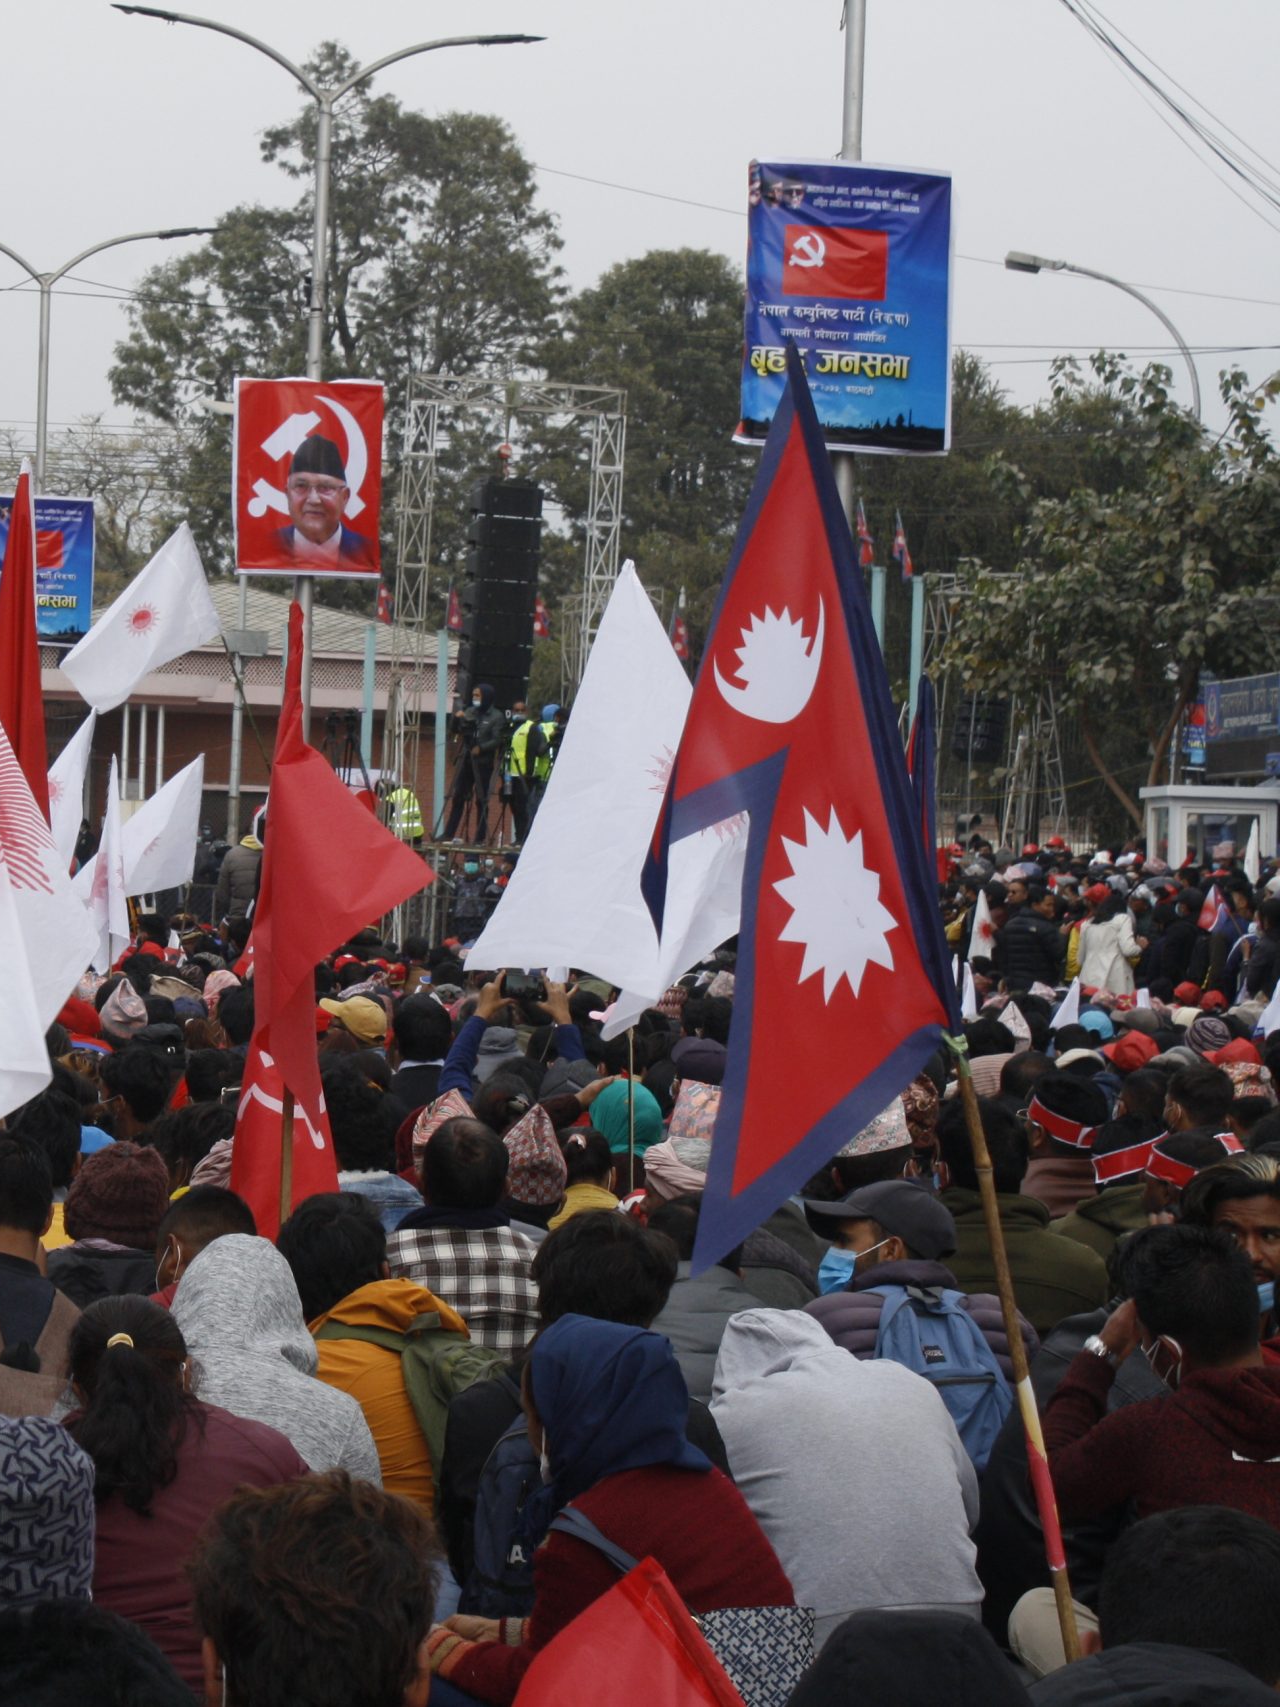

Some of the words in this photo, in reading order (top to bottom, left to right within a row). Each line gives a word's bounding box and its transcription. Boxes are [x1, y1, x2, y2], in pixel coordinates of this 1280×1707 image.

[759, 301, 790, 318] नेपाल
[842, 306, 865, 322] पार्टी
[816, 349, 911, 379] जनसभा
